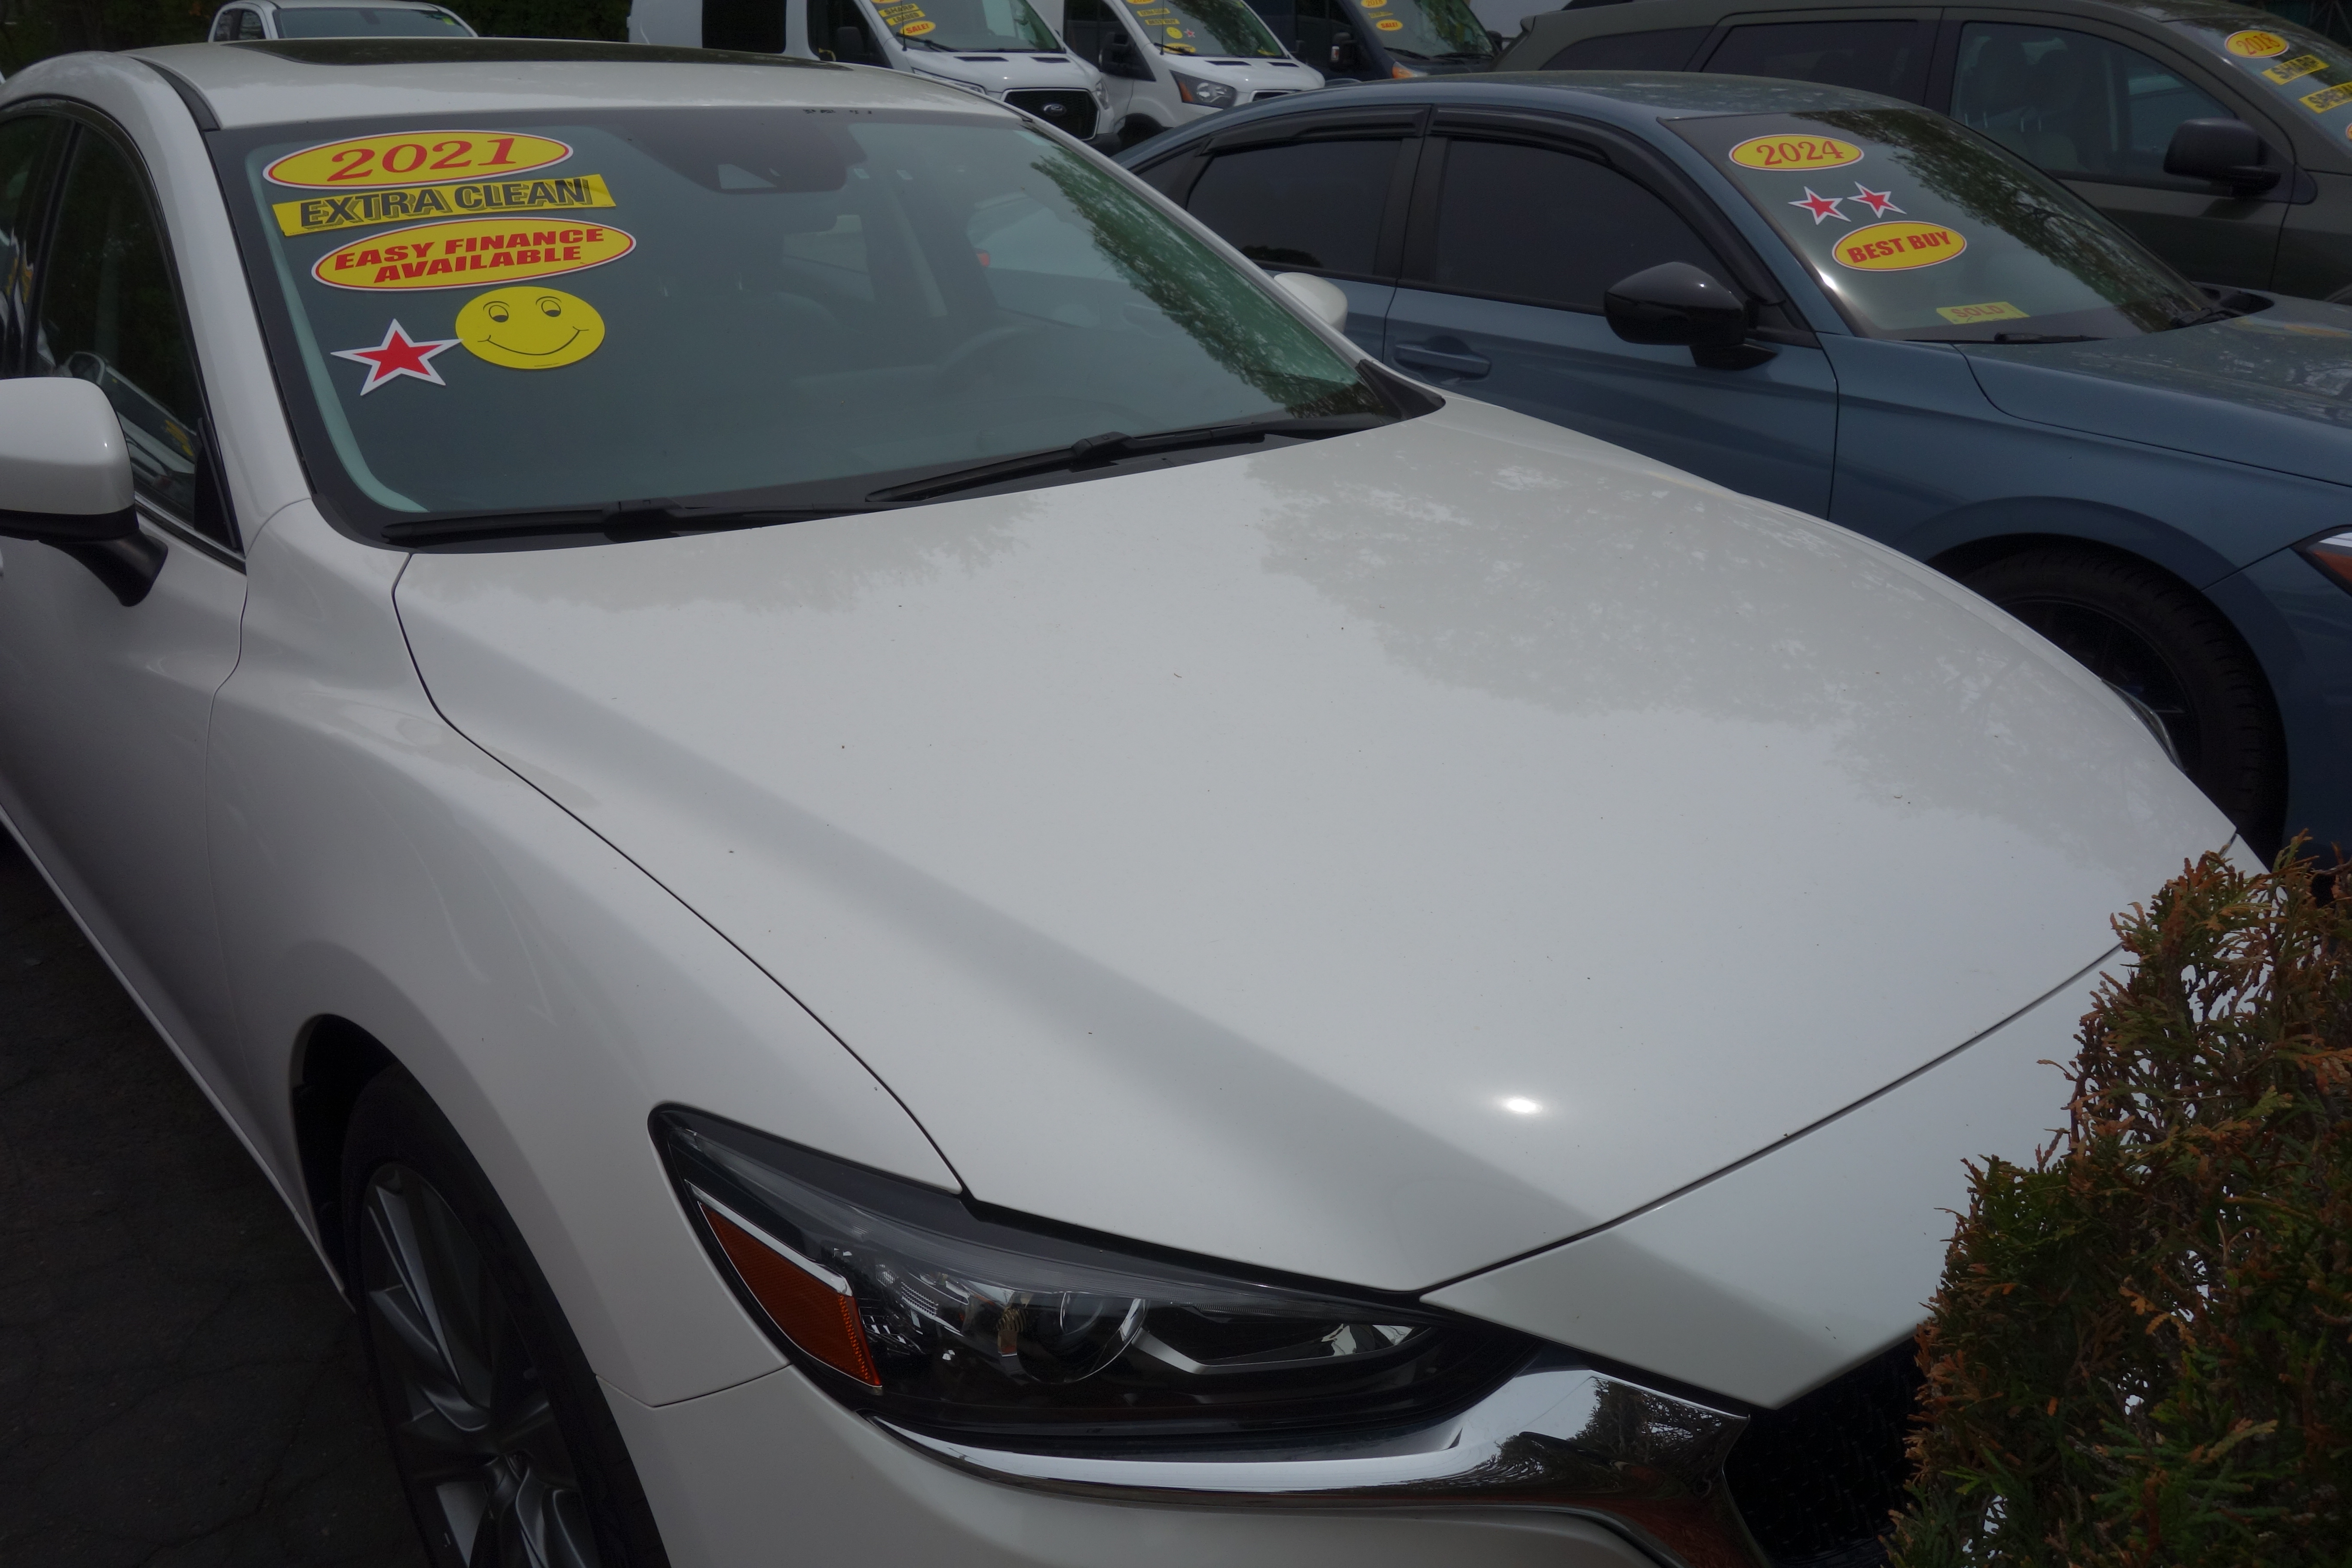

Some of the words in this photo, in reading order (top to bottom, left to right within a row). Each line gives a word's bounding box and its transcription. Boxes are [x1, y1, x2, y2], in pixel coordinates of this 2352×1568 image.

[884, 5, 915, 15] SHARP
[892, 12, 919, 23] LOADED
[906, 23, 930, 34] SALE!
[327, 138, 516, 181] 2021
[1756, 141, 1844, 165] 2024
[300, 189, 449, 229] EXTRA
[454, 178, 591, 210] CLEAN
[335, 242, 435, 270] EASY
[445, 228, 603, 254] FINANCE
[1847, 238, 1905, 263] BEST
[1907, 231, 1951, 250] BUY
[374, 246, 581, 283] AVAILABLE
[1951, 305, 2005, 318] SOLD
